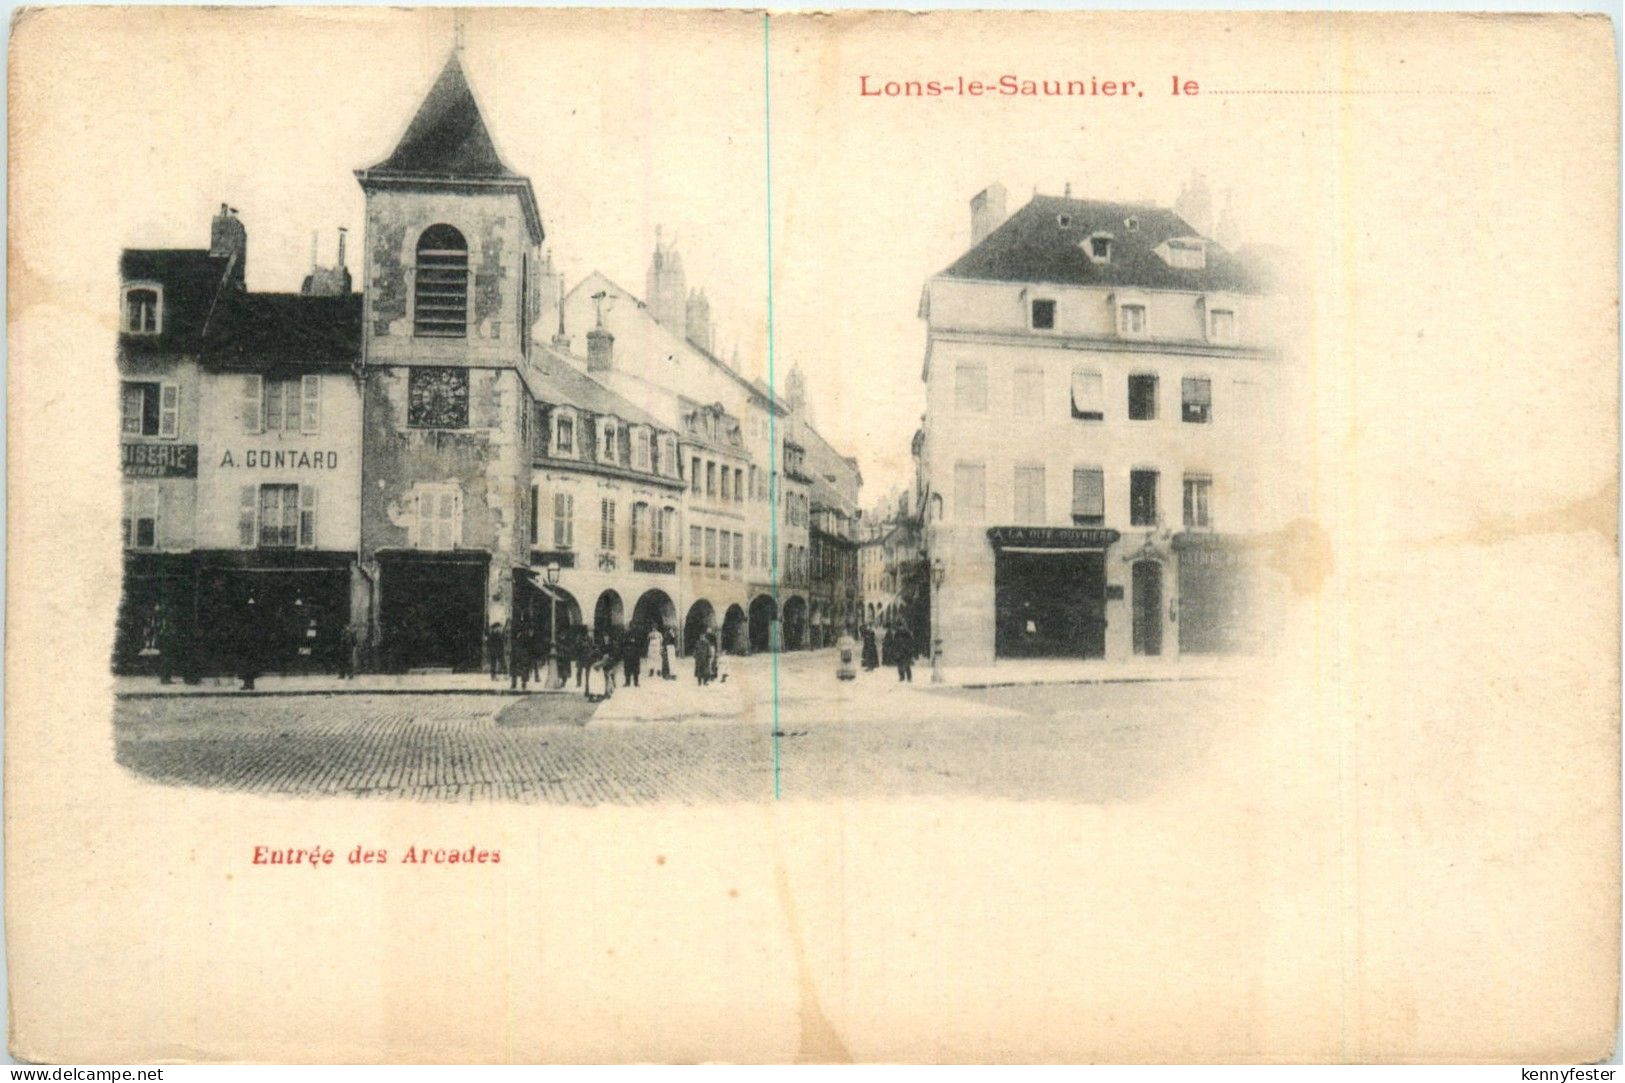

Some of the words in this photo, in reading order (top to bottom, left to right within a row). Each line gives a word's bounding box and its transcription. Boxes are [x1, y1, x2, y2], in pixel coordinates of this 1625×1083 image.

[1170, 75, 1200, 97] le
[220, 450, 240, 469] A.
[246, 450, 338, 469] GONTARD
[252, 845, 334, 868] Entrée
[347, 845, 388, 864] des
[401, 845, 502, 864] Arcades
